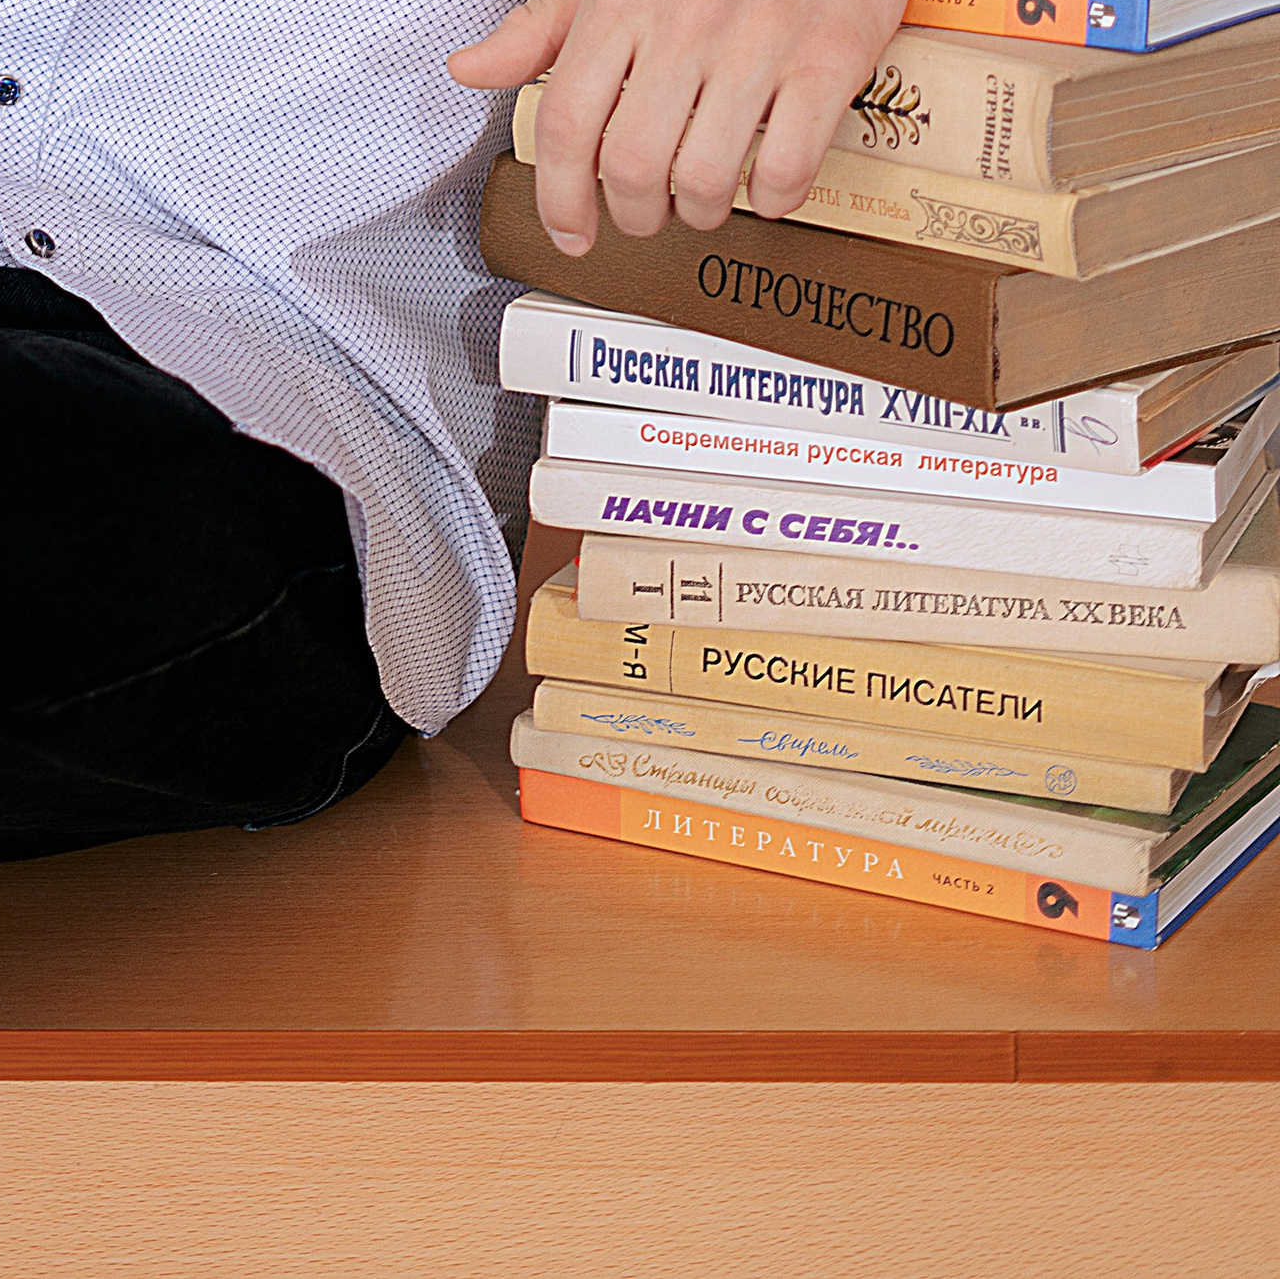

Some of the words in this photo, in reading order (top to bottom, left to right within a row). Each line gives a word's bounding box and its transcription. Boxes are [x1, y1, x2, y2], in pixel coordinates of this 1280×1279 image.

[976, 74, 998, 180] СТРАНИЦЫ
[997, 79, 1015, 180] ЖИВЫЕ
[849, 192, 877, 215] XIX
[698, 254, 955, 358] ОТРОЧЕСТВО
[640, 423, 799, 458] Современная
[807, 443, 903, 468] русская
[918, 454, 1059, 485] литература
[601, 495, 734, 531] НАЧНИ
[742, 509, 769, 535] С
[779, 513, 920, 550] СЕБЯ!..
[736, 582, 865, 610] РУССКАЯ
[871, 589, 1052, 621] ЛИТЕРАТУРА
[1059, 599, 1105, 624] XX
[1108, 601, 1187, 630] ВЕКА
[702, 647, 856, 694] РУССКИЕ
[866, 672, 1043, 723] ПИСАТЕЛИ
[632, 753, 756, 799] Страницы
[740, 731, 860, 759] Свирель
[644, 809, 905, 879] ЛИТЕРАТУРА
[932, 873, 980, 892] ЧАСТЬ
[986, 884, 995, 895] 2
